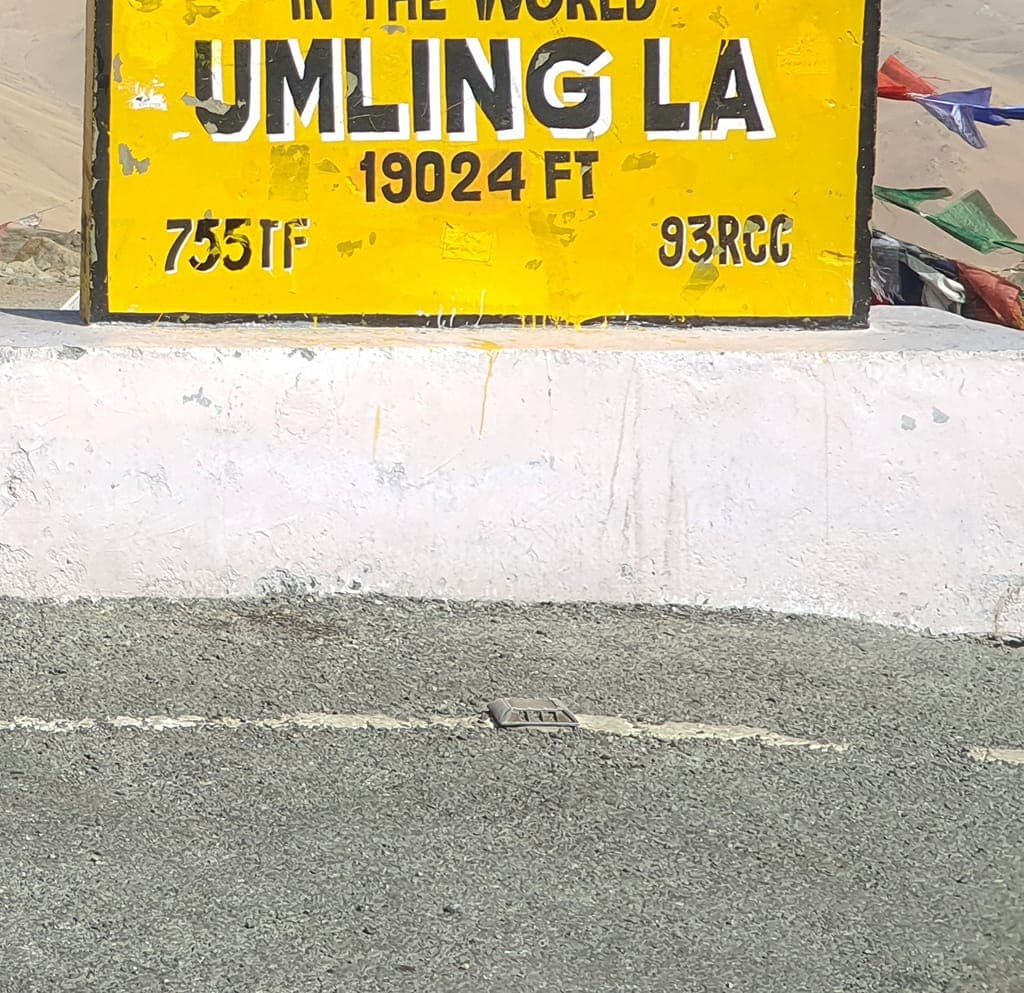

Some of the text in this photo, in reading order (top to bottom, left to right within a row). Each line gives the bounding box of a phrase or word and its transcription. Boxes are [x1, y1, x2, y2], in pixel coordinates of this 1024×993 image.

[195, 37, 777, 143] UMLING LA
[359, 150, 600, 204] 19024 FT
[658, 214, 793, 269] 93RCC
